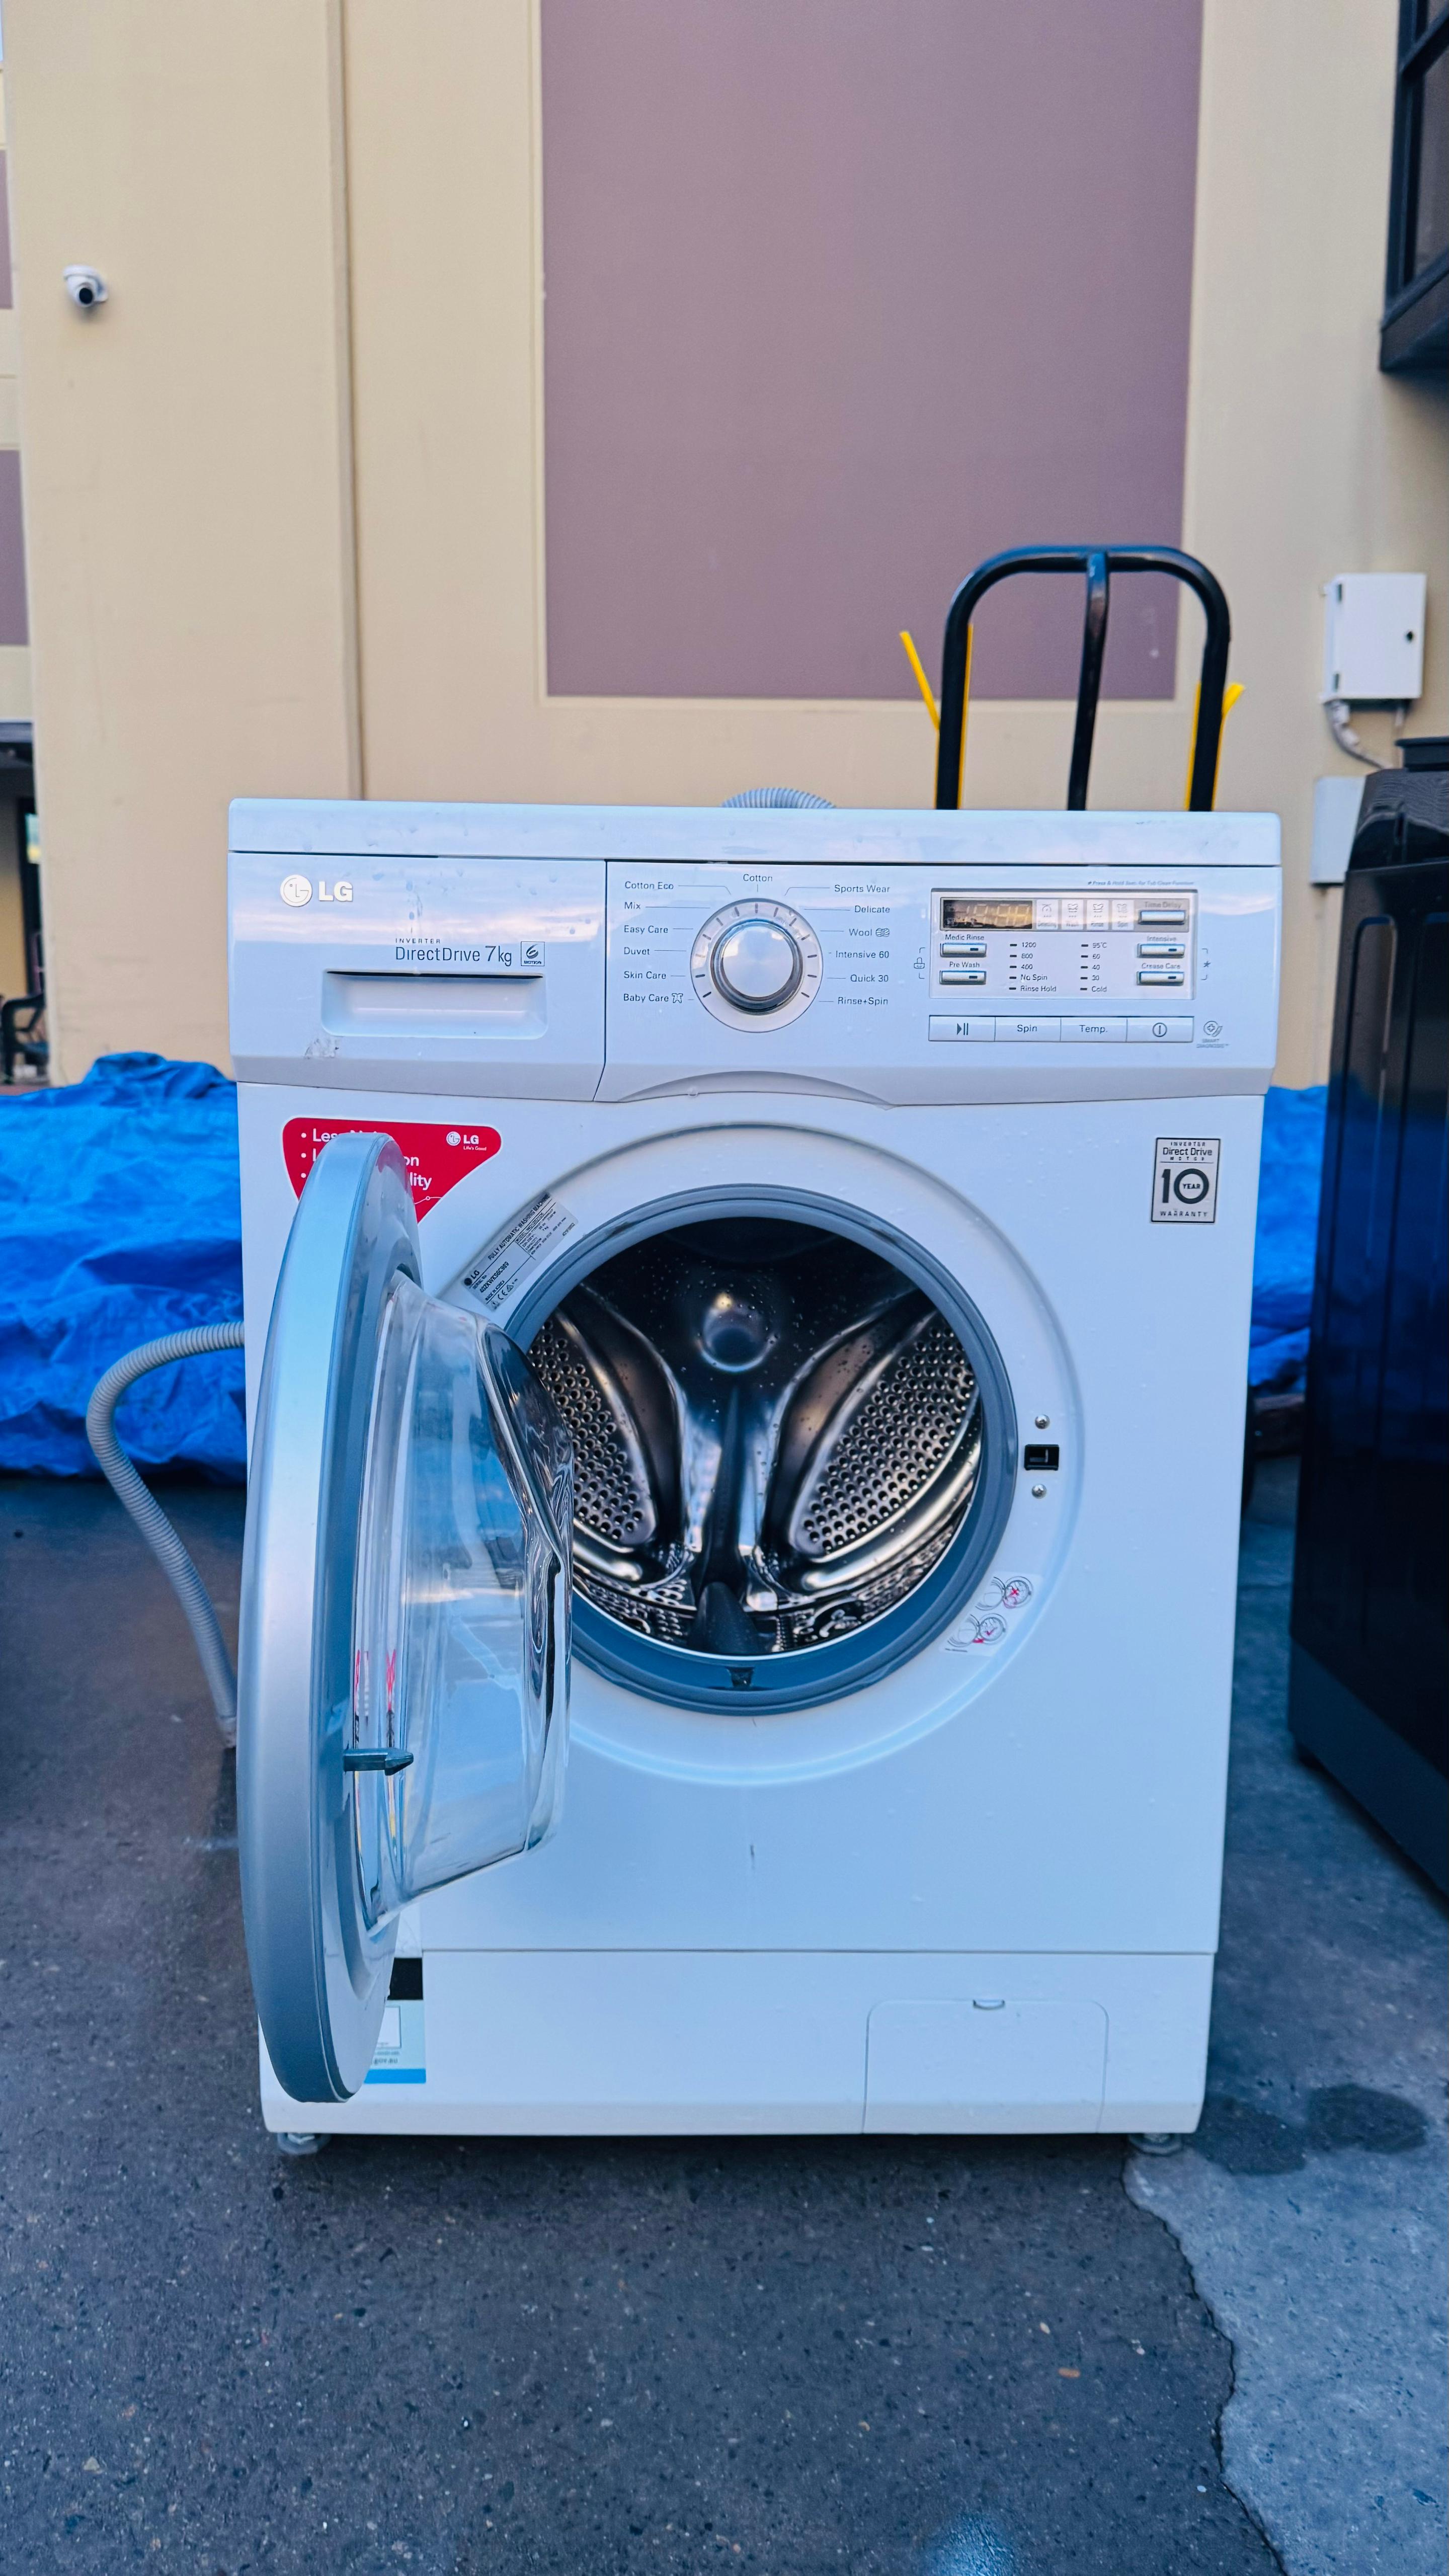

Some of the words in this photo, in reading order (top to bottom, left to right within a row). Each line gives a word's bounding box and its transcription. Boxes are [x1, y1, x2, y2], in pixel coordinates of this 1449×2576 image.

[743, 873, 773, 881] Cotton
[625, 881, 655, 890] Cotton
[658, 882, 674, 890] Eco
[834, 884, 864, 894] Sports
[866, 885, 890, 893] Wear
[319, 881, 353, 902] LG
[624, 902, 641, 910] Mix
[854, 905, 891, 914] Delicate
[624, 925, 644, 934] Easy
[648, 926, 669, 934] Care
[849, 929, 873, 937] Wool
[624, 947, 650, 955] Duvet
[836, 950, 876, 959] Intensive
[879, 950, 890, 958] 60
[624, 972, 642, 980] Skin
[646, 972, 667, 980] Care
[850, 975, 876, 983] Quick
[878, 975, 889, 983] 30
[623, 994, 646, 1004] Baby
[648, 994, 669, 1003] Care
[837, 997, 889, 1007] Rinse+Spin
[1017, 1024, 1038, 1033] Spin
[1079, 1024, 1108, 1034] Temp.
[463, 1135, 479, 1145] LG
[1163, 1147, 1188, 1156] Direct
[1190, 1147, 1213, 1156] Drive
[1161, 1168, 1210, 1204] 10
[470, 1269, 480, 1279] LG
